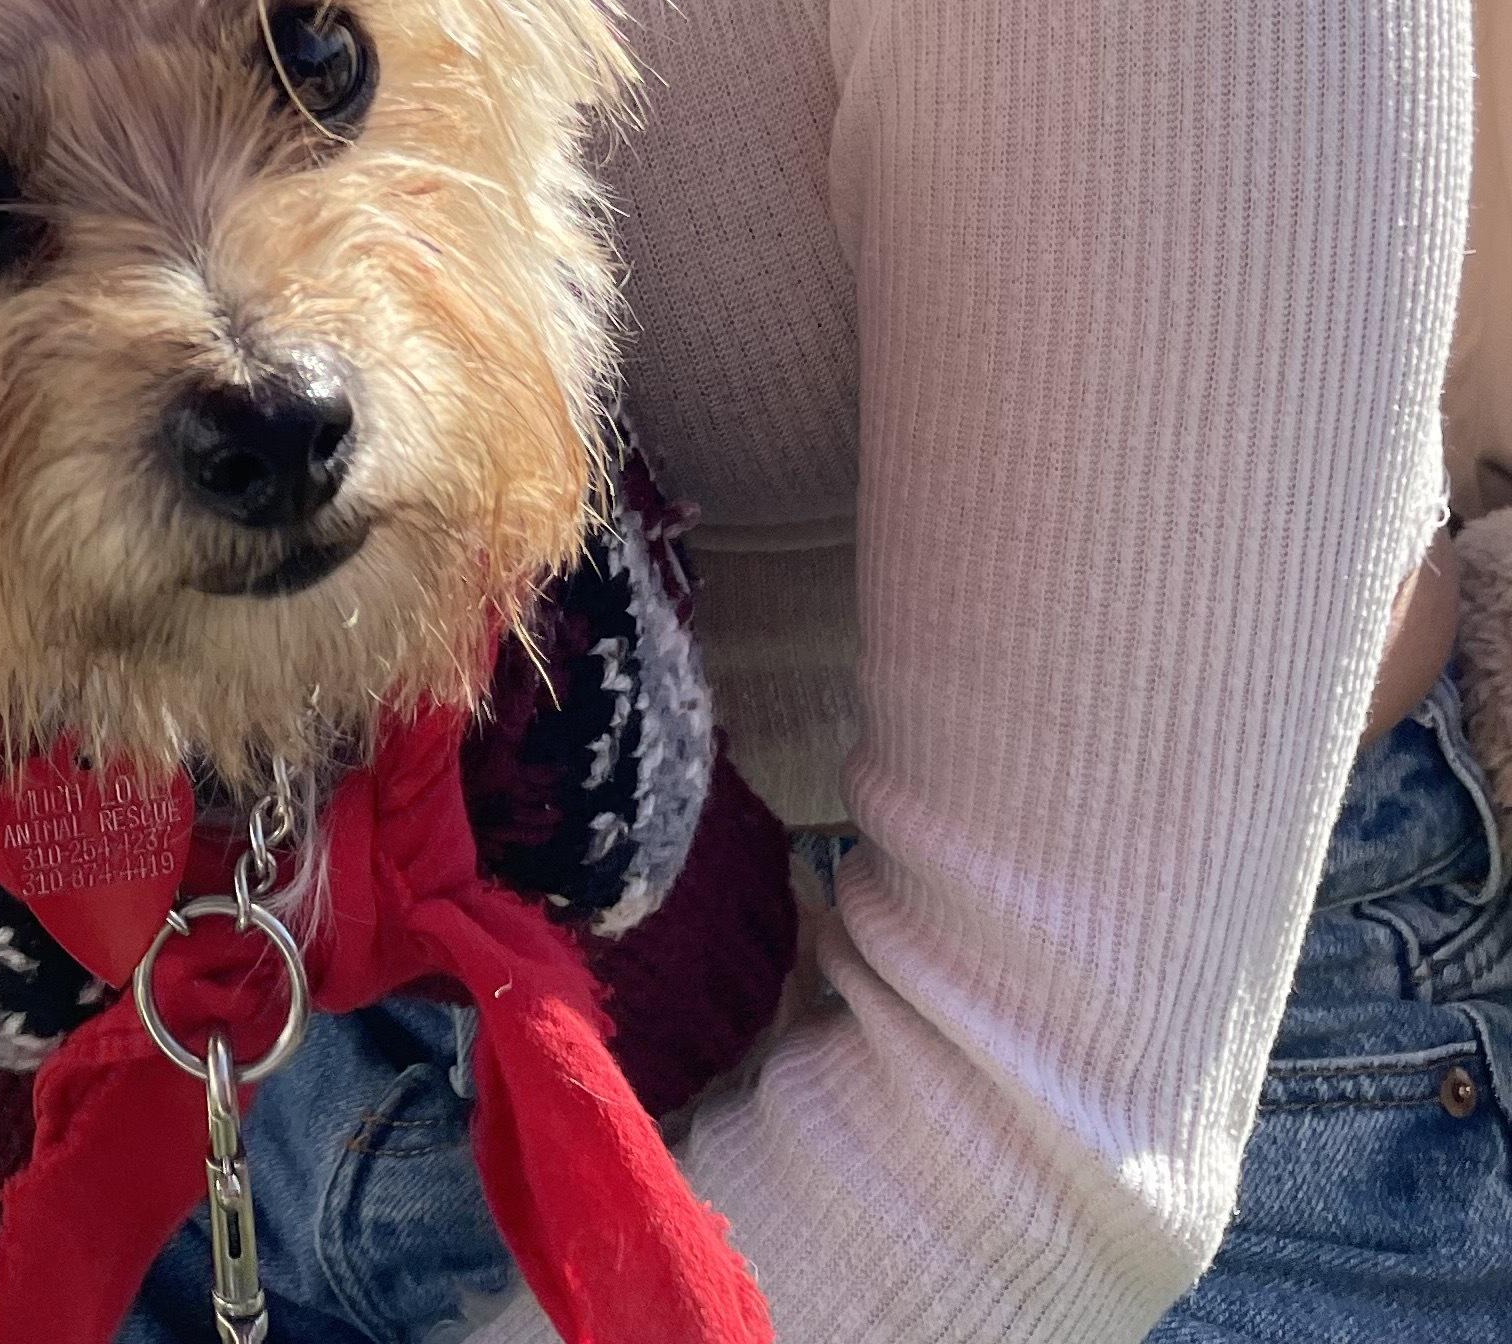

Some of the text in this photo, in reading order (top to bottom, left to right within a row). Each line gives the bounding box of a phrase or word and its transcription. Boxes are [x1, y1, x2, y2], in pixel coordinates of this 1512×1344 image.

[101, 774, 172, 808] LO
[3, 798, 183, 849] ANIMAL RESCUE
